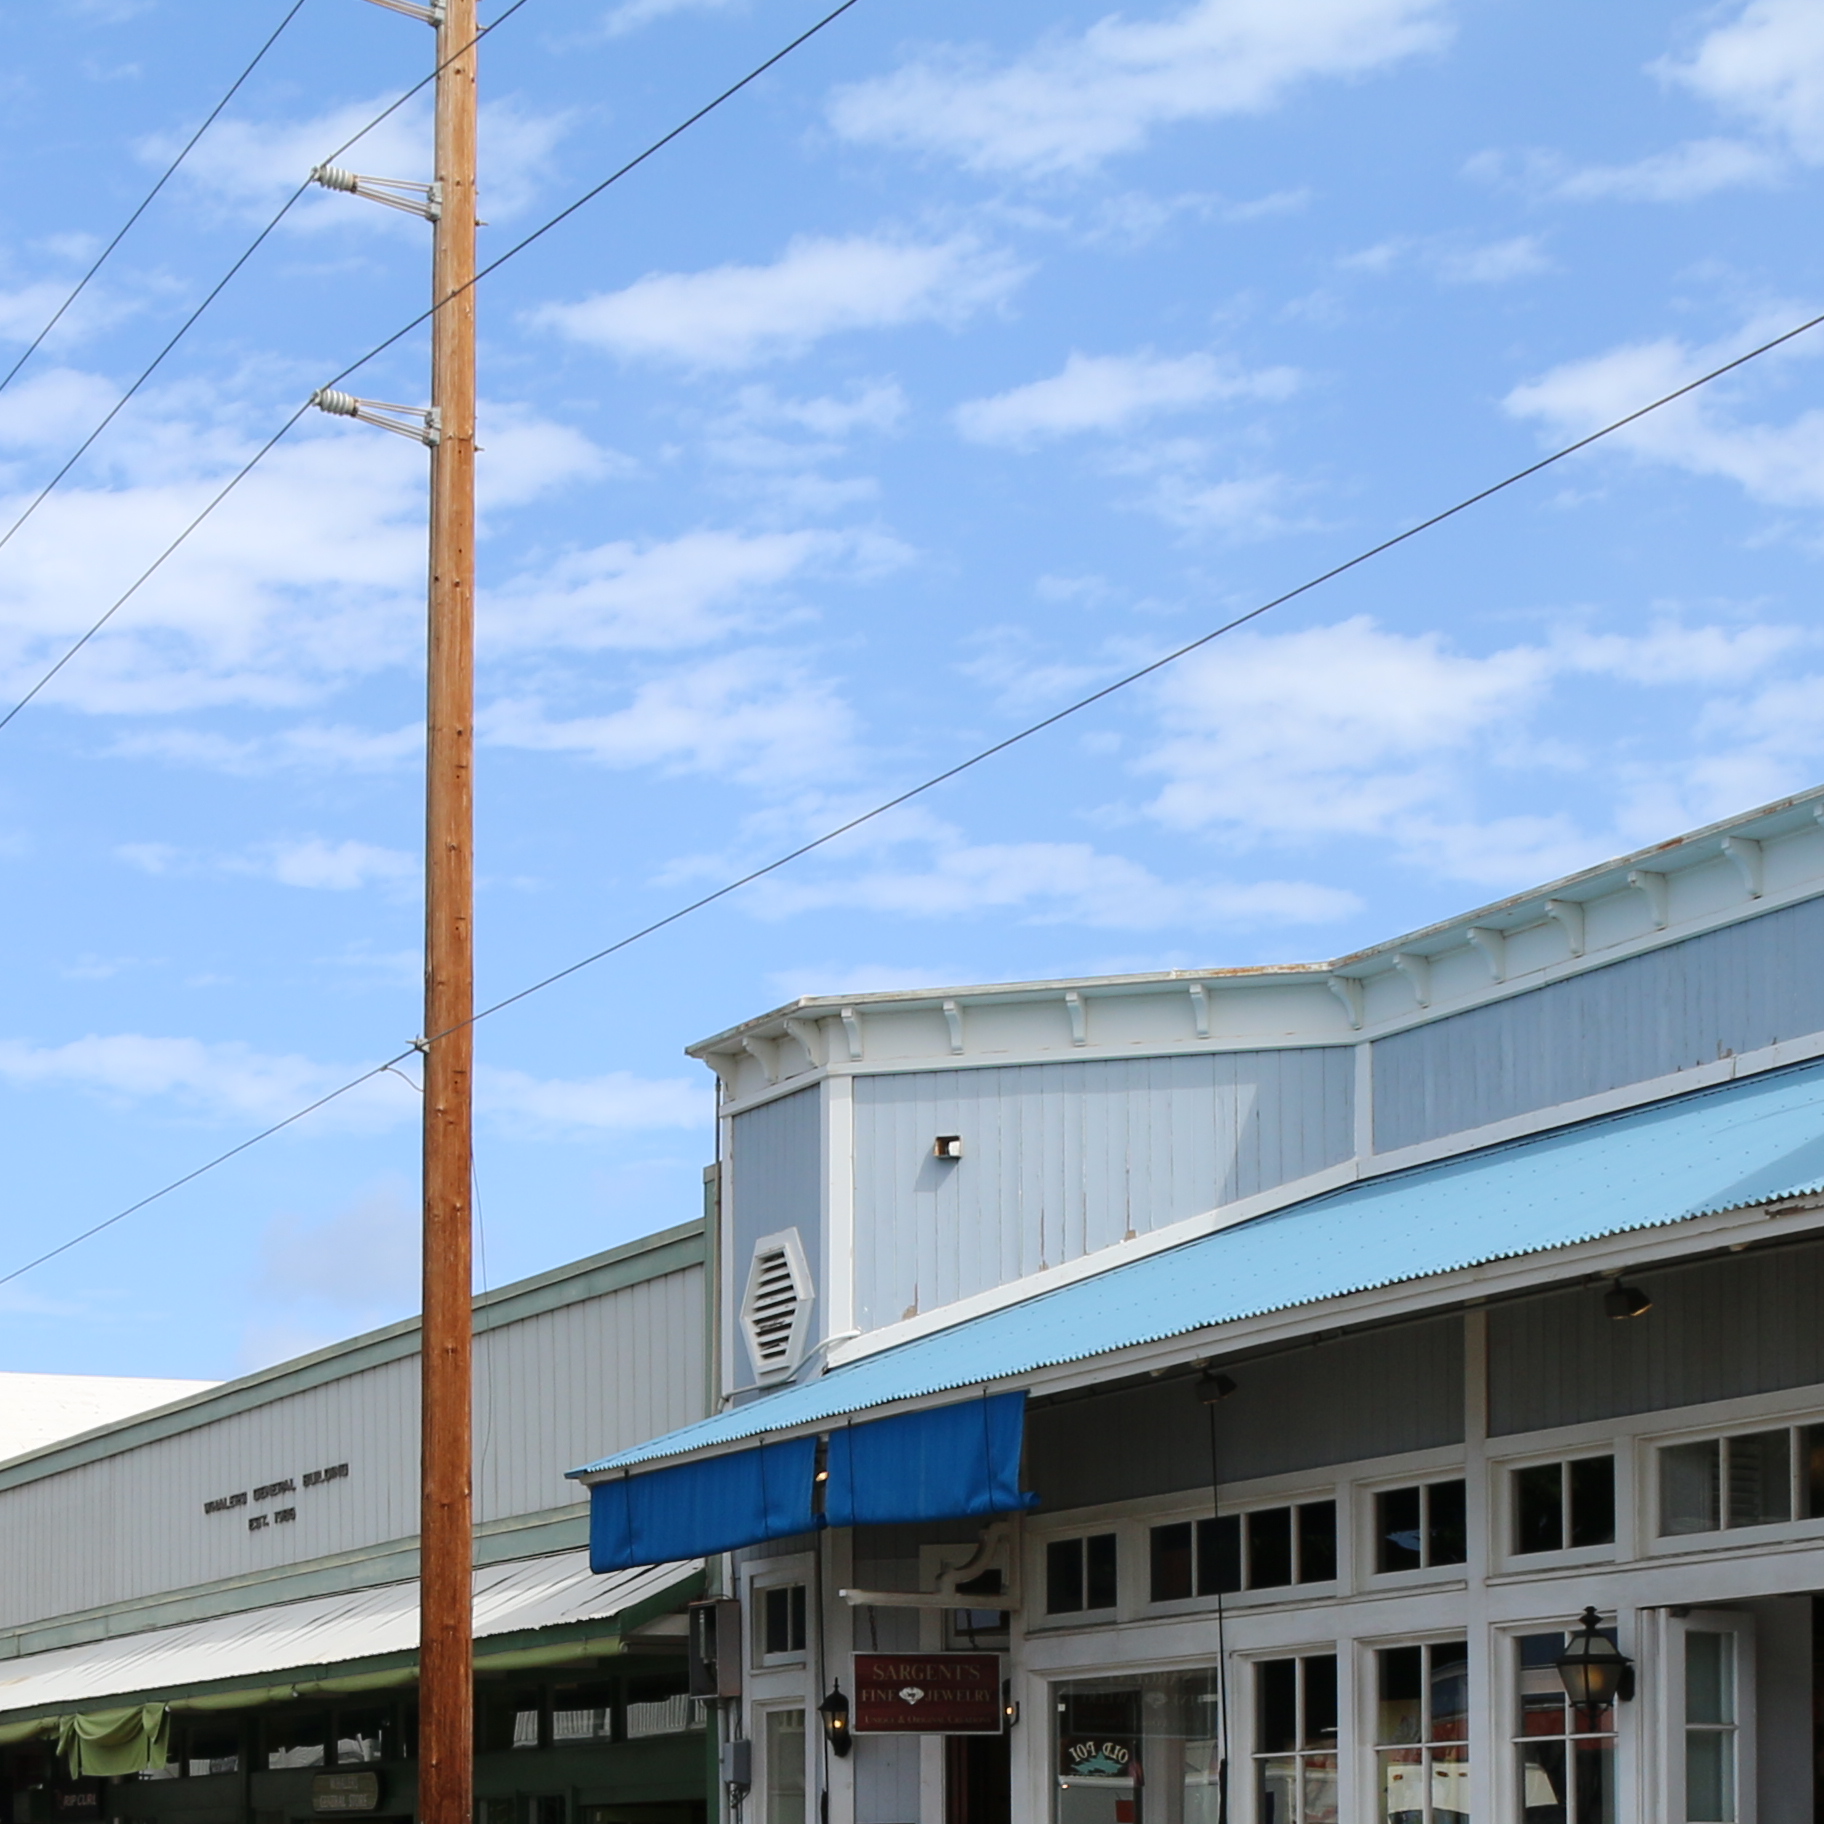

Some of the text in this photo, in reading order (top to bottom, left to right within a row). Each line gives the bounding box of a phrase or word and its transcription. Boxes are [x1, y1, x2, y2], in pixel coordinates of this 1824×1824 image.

[253, 1479, 296, 1502] GENERAL
[303, 1462, 349, 1487] BUILDING
[873, 1664, 980, 1680] SARGENT'S
[862, 1690, 992, 1701] FINE JEWELRY
[63, 1794, 96, 1806] RIP CURL
